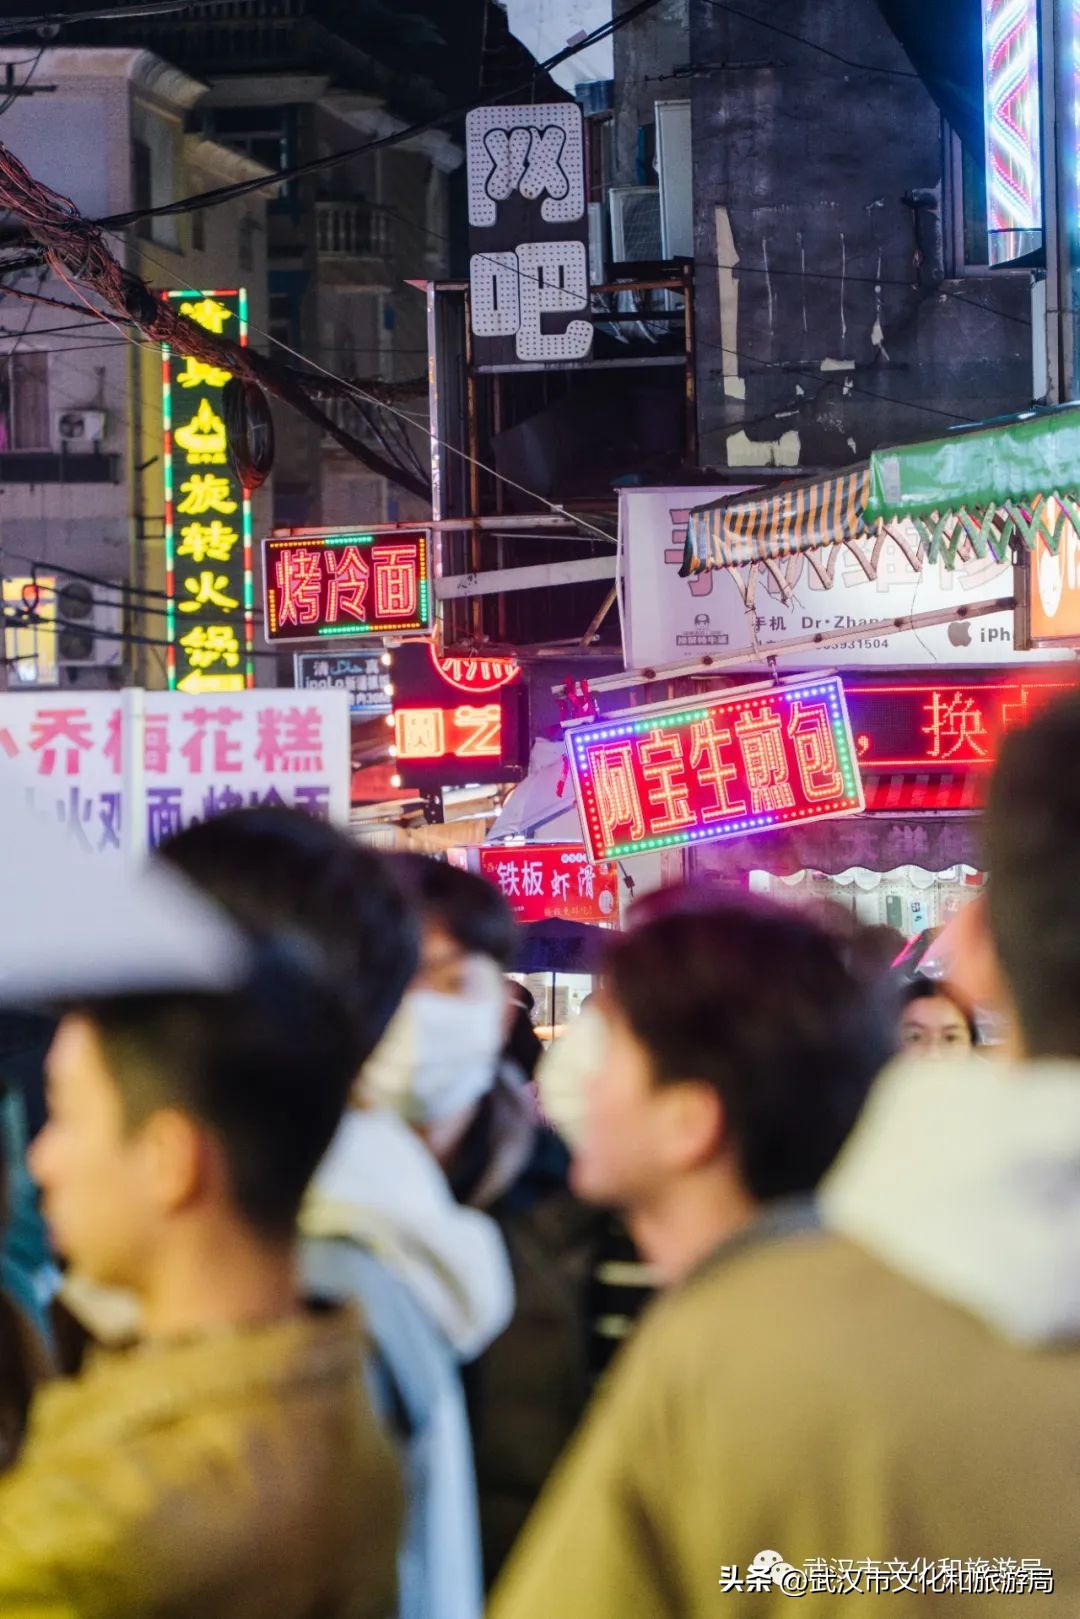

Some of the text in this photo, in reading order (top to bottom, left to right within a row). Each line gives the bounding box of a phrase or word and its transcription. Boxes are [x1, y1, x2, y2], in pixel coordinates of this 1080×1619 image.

[466, 102, 593, 361] 网吧
[276, 544, 418, 627] 烤冷面
[586, 701, 845, 848] 阿宝生煎包
